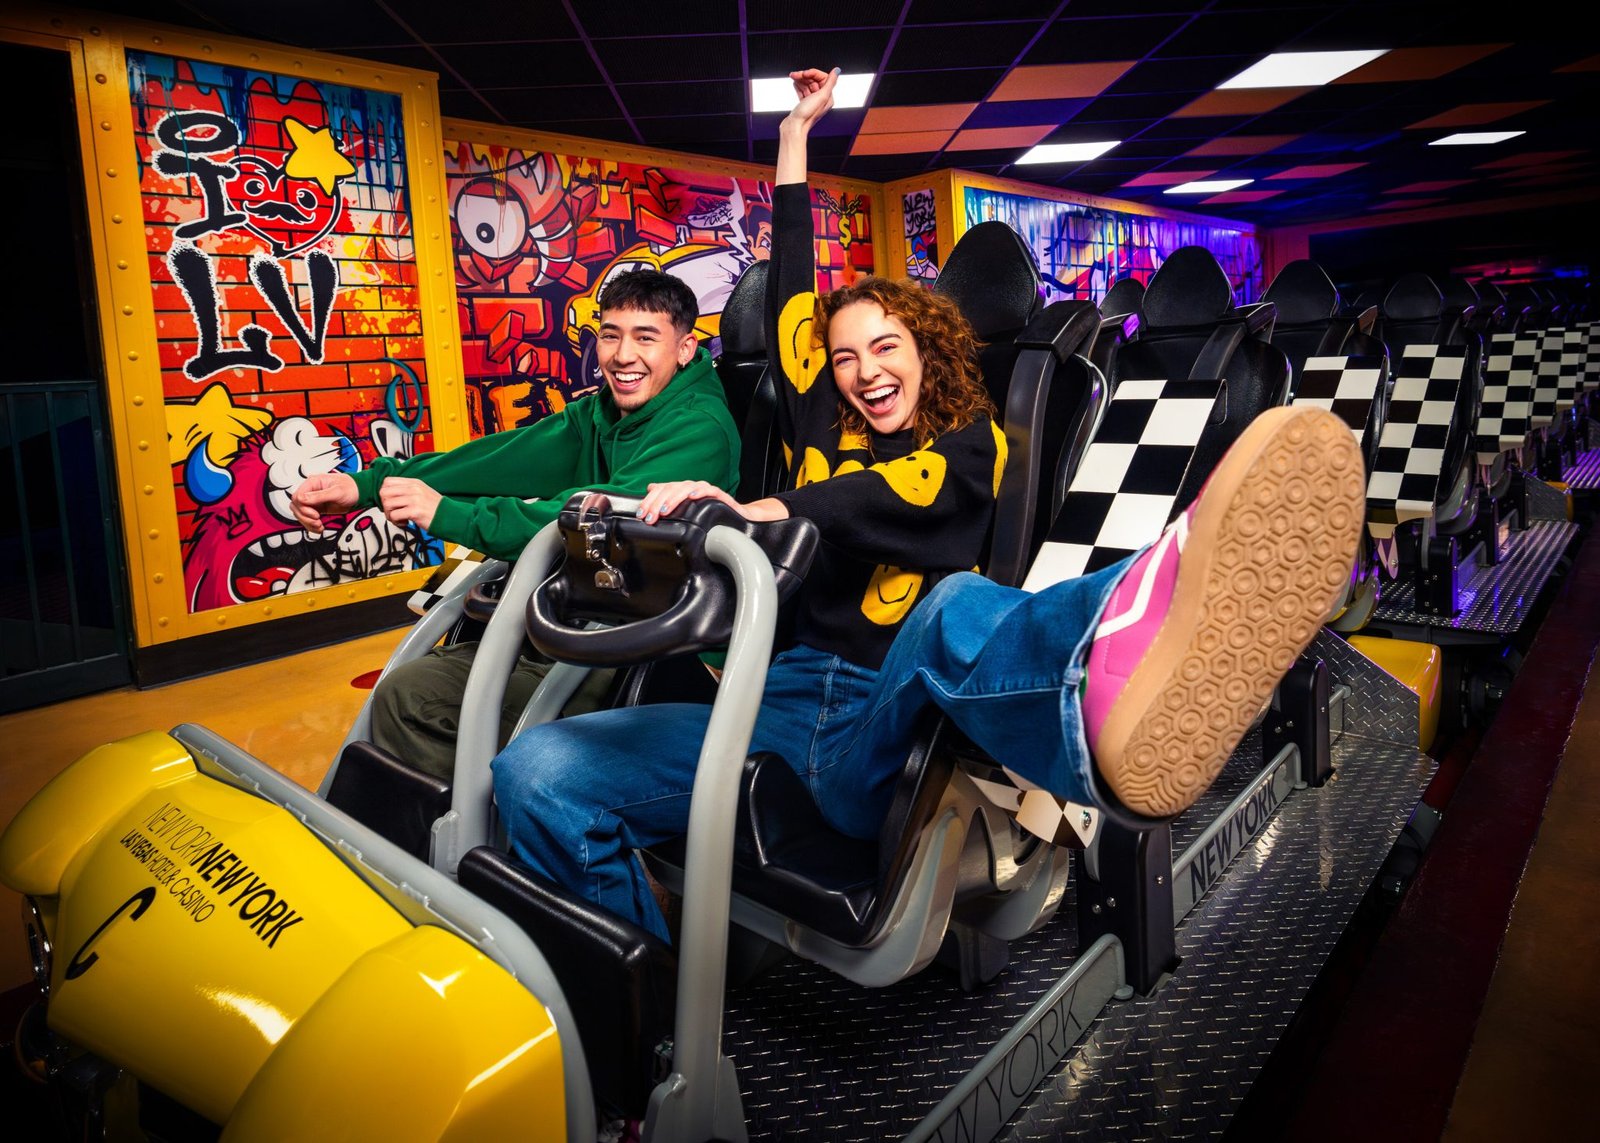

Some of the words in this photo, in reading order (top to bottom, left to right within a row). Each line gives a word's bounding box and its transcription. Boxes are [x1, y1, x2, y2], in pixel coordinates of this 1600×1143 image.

[167, 242, 339, 382] LV
[119, 828, 143, 850] LAS
[128, 835, 159, 865] VEGAS
[145, 852, 176, 882] HOTEL
[160, 868, 182, 888] &
[169, 876, 216, 923] CASINO
[64, 886, 157, 981] C
[984, 979, 1083, 1123] YORK
